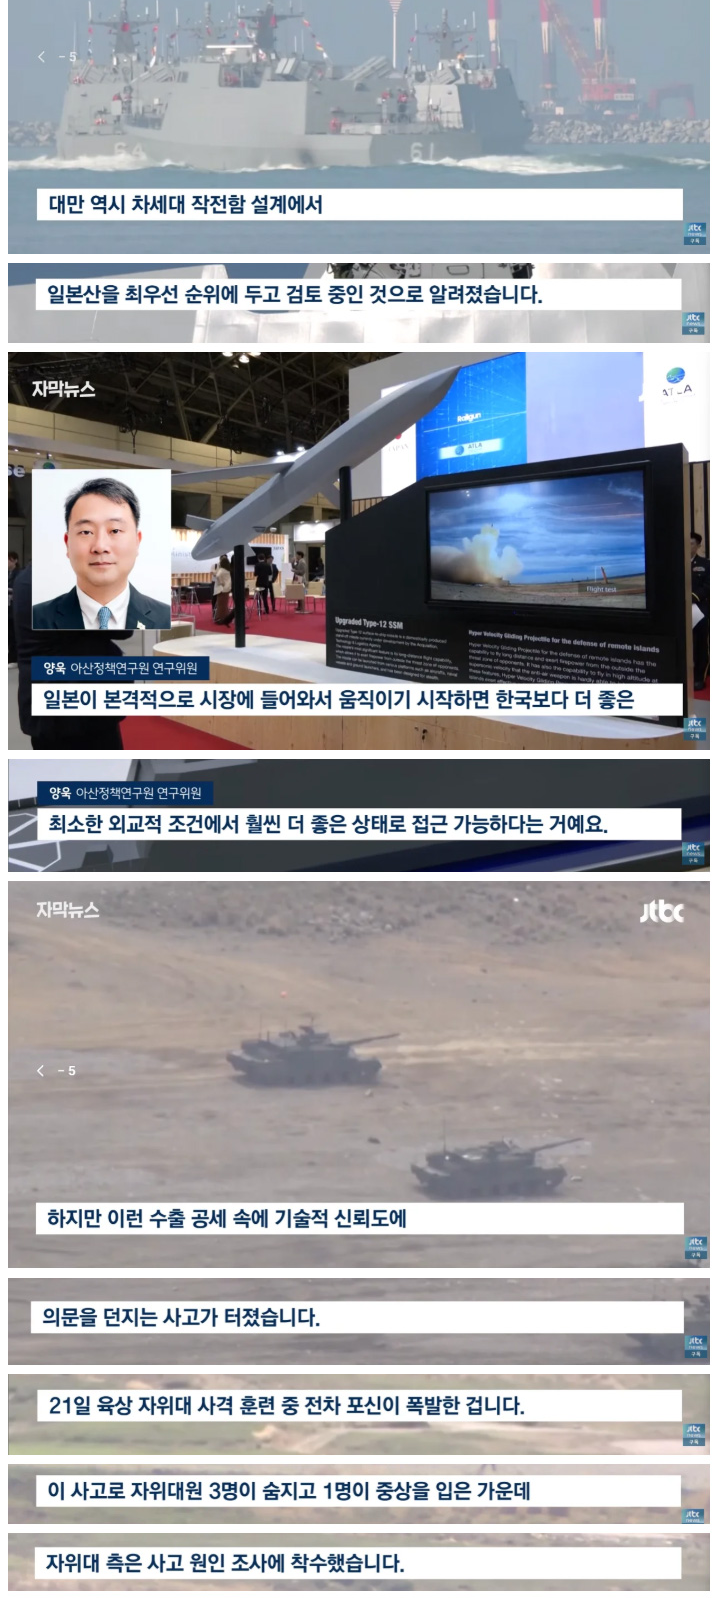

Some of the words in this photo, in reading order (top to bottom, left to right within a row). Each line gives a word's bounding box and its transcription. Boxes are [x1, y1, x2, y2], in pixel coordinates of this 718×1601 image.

[114, 141, 145, 159] 64
[410, 142, 435, 161] 61
[457, 412, 481, 422] Railgun
[586, 585, 602, 593] Flight
[335, 616, 361, 627] Upgraded
[363, 619, 387, 629] Type-12
[388, 621, 403, 629] SSM
[483, 631, 503, 639] Velocity
[504, 633, 522, 641] Gliding
[524, 634, 550, 643] Projectile
[573, 638, 598, 647] defense
[599, 640, 607, 648] of
[608, 642, 632, 651] remote
